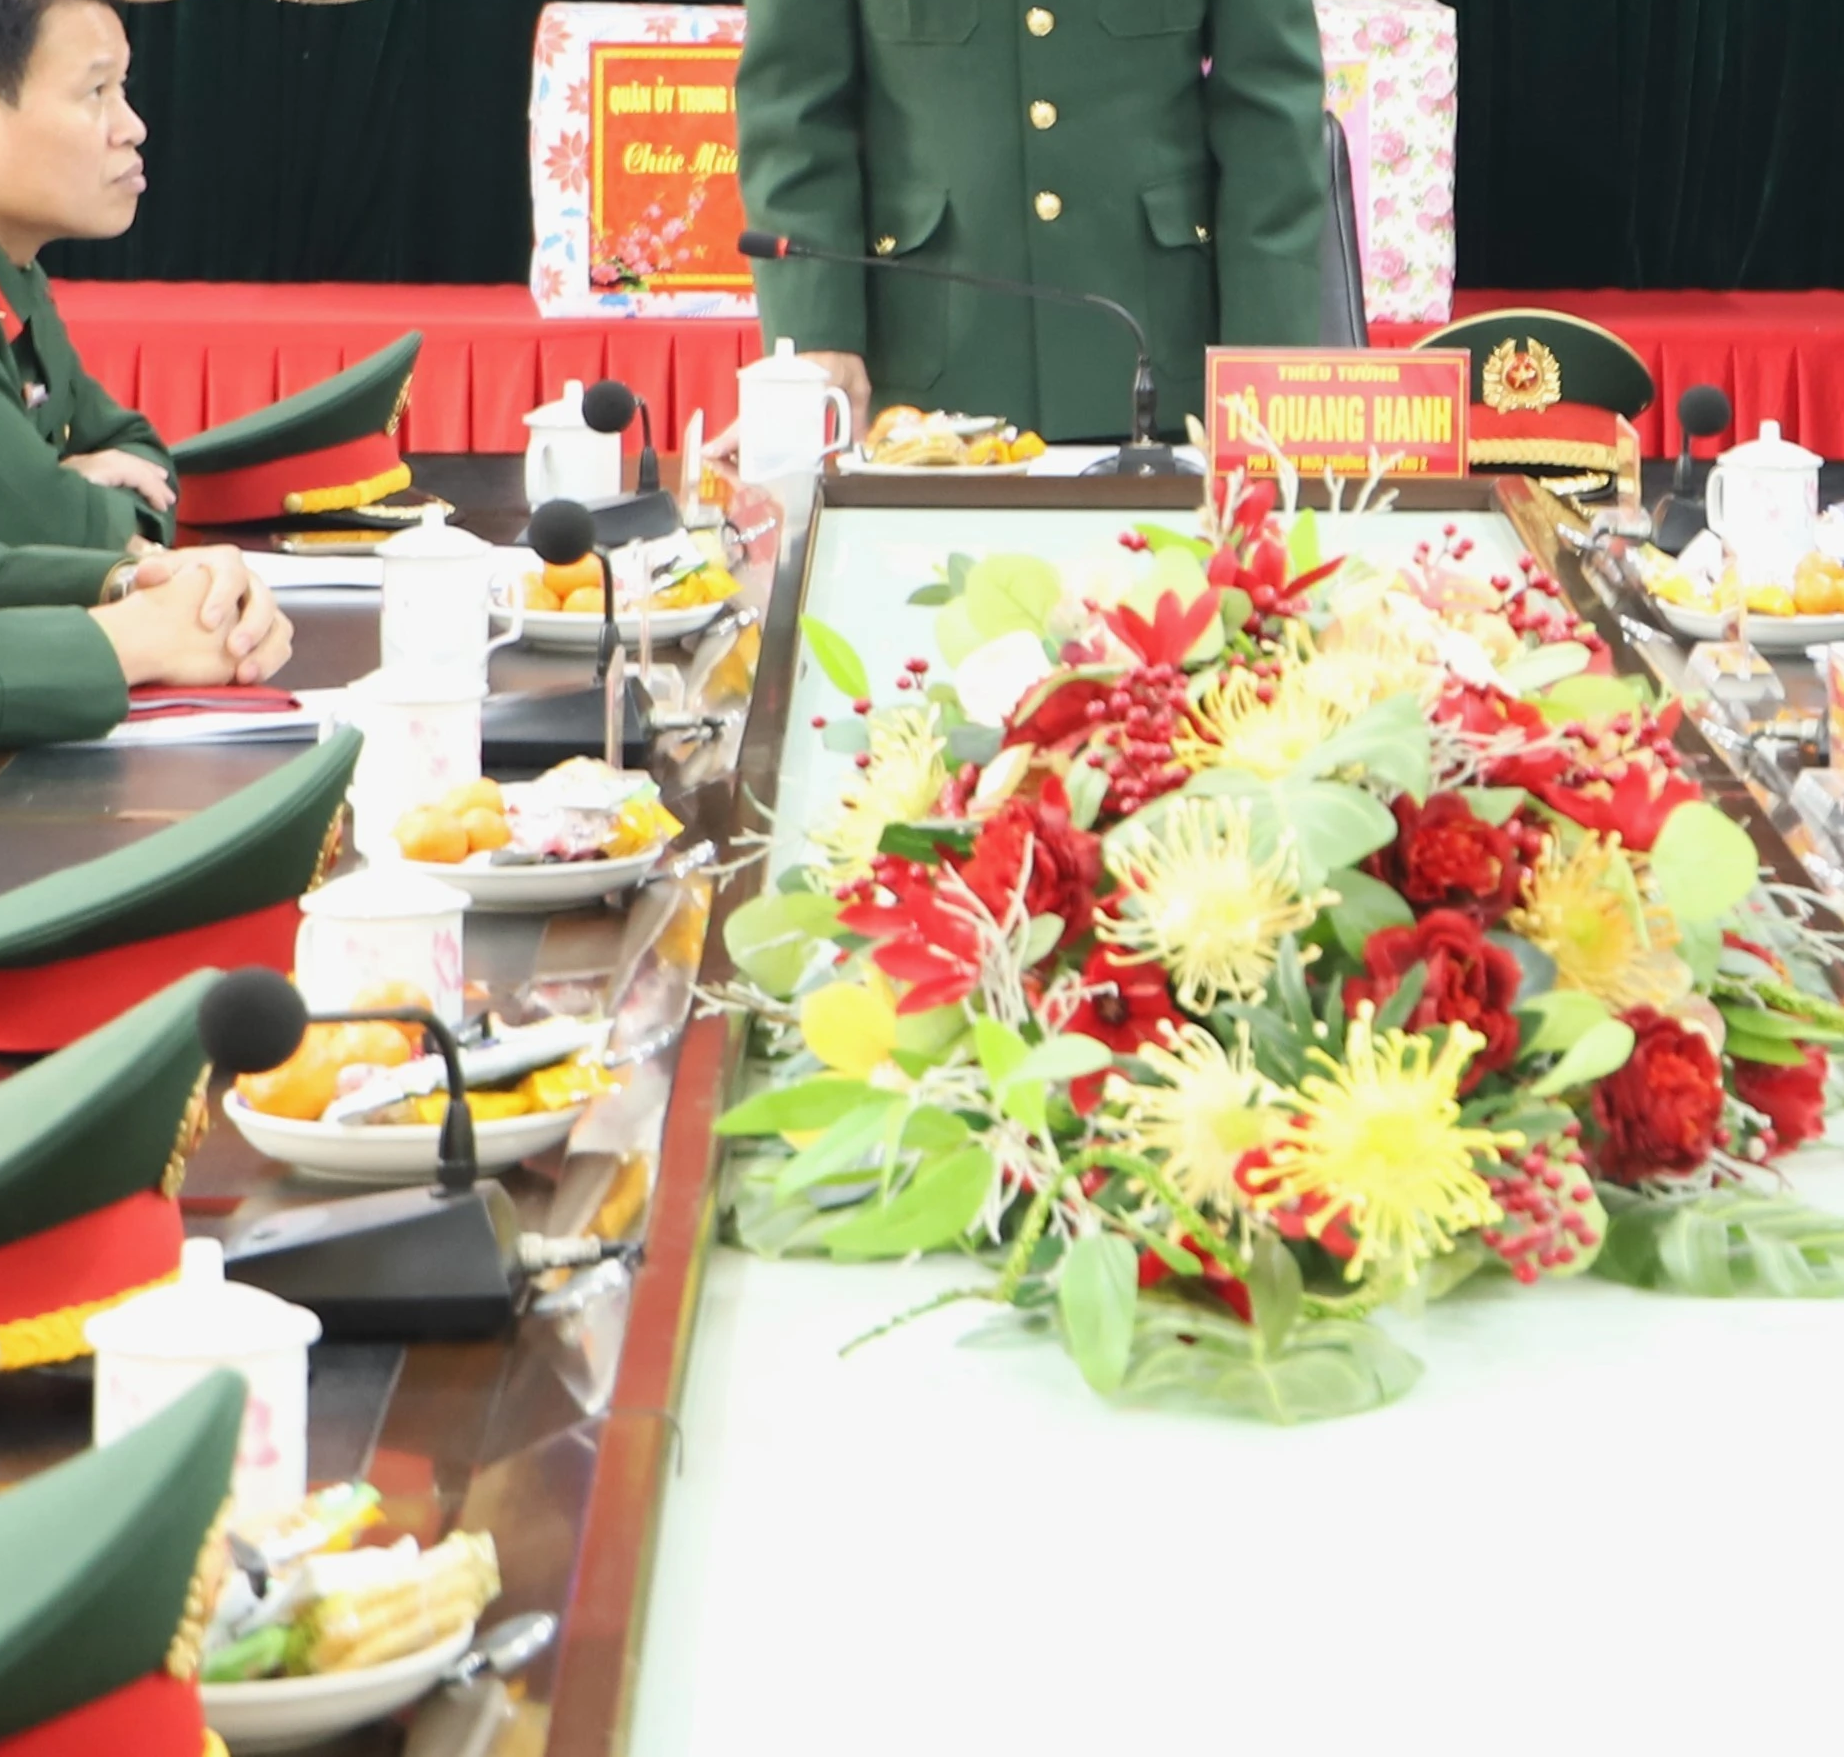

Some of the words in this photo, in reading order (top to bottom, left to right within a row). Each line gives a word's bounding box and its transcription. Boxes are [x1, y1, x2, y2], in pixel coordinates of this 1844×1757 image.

[609, 80, 652, 115] QUÂN
[622, 141, 685, 175] Chúc
[1267, 394, 1366, 447] QUANG
[1373, 395, 1453, 443] HANH
